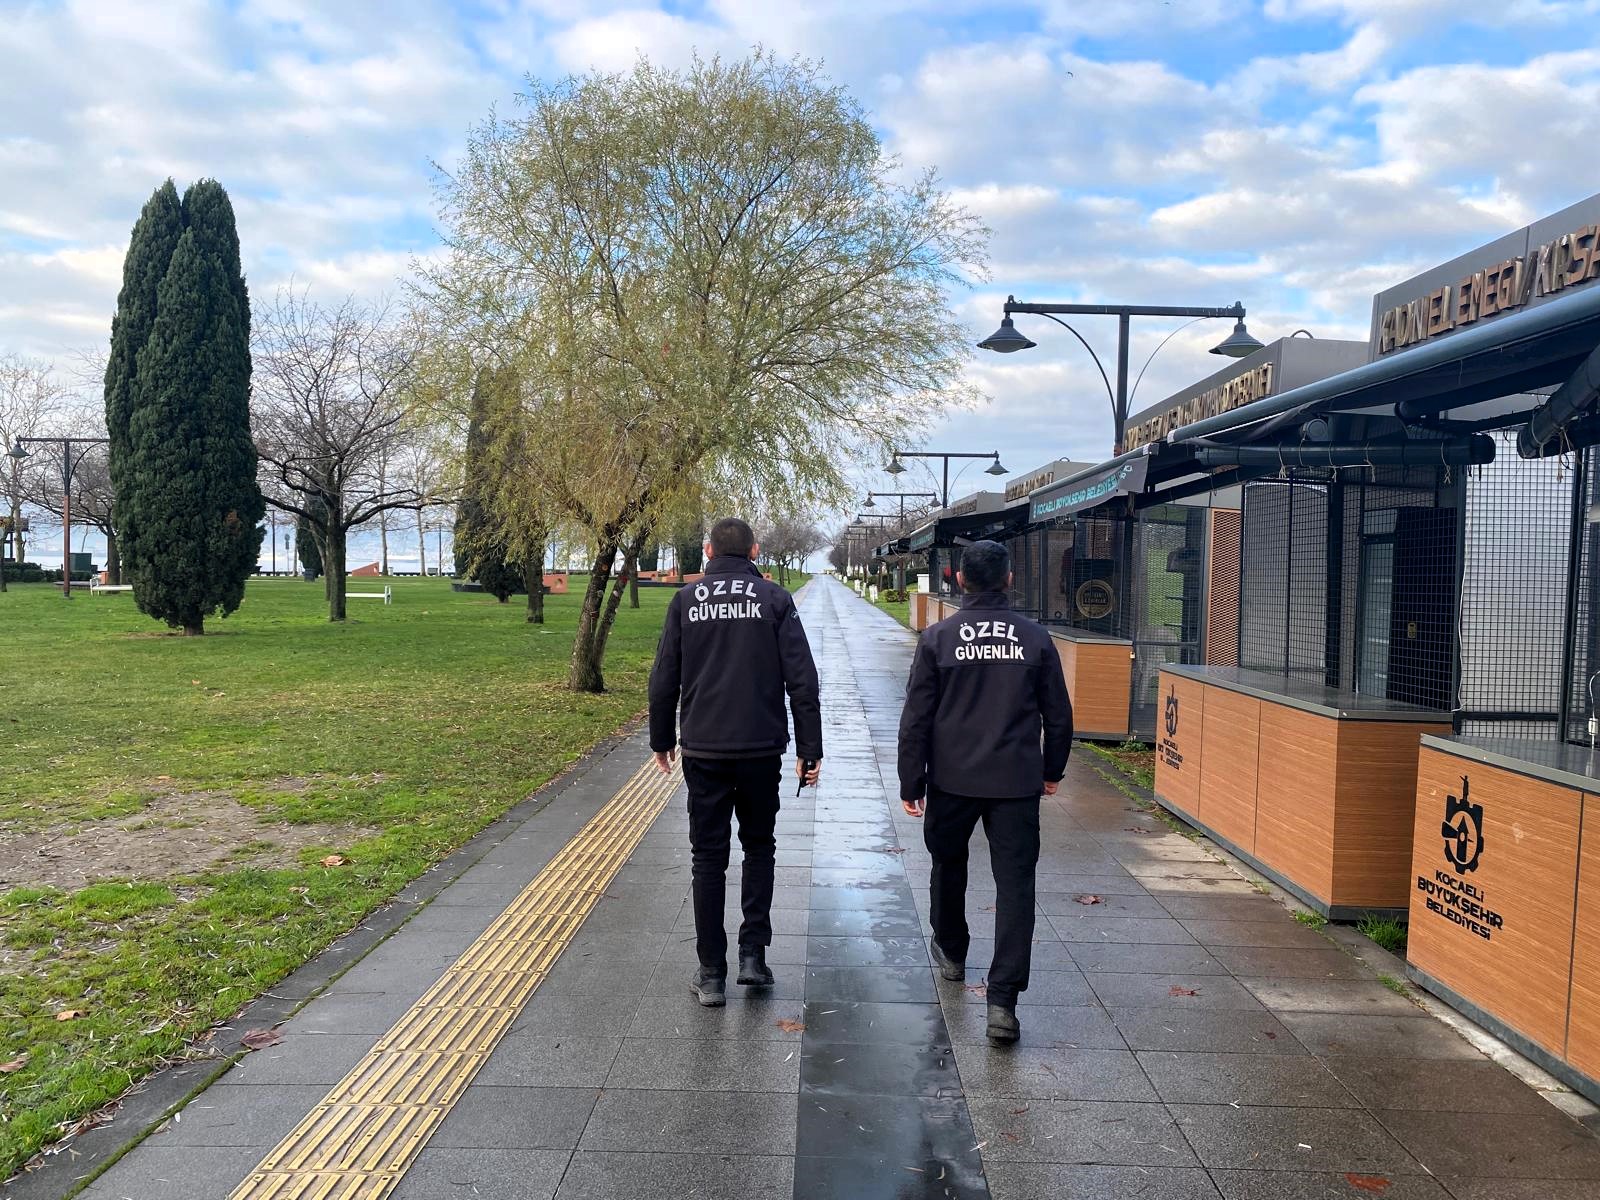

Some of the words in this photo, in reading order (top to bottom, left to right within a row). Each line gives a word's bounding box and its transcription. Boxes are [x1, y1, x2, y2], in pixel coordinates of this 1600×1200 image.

[694, 579, 758, 602] ÖZEL
[688, 600, 762, 622] GÜVENLİK
[959, 621, 1019, 643] ÖZEL
[955, 642, 1025, 661] GÜVENLİK
[1417, 875, 1504, 931] BÜYÜKŞEHİR
[1426, 896, 1491, 941] BELEDİYESİ
